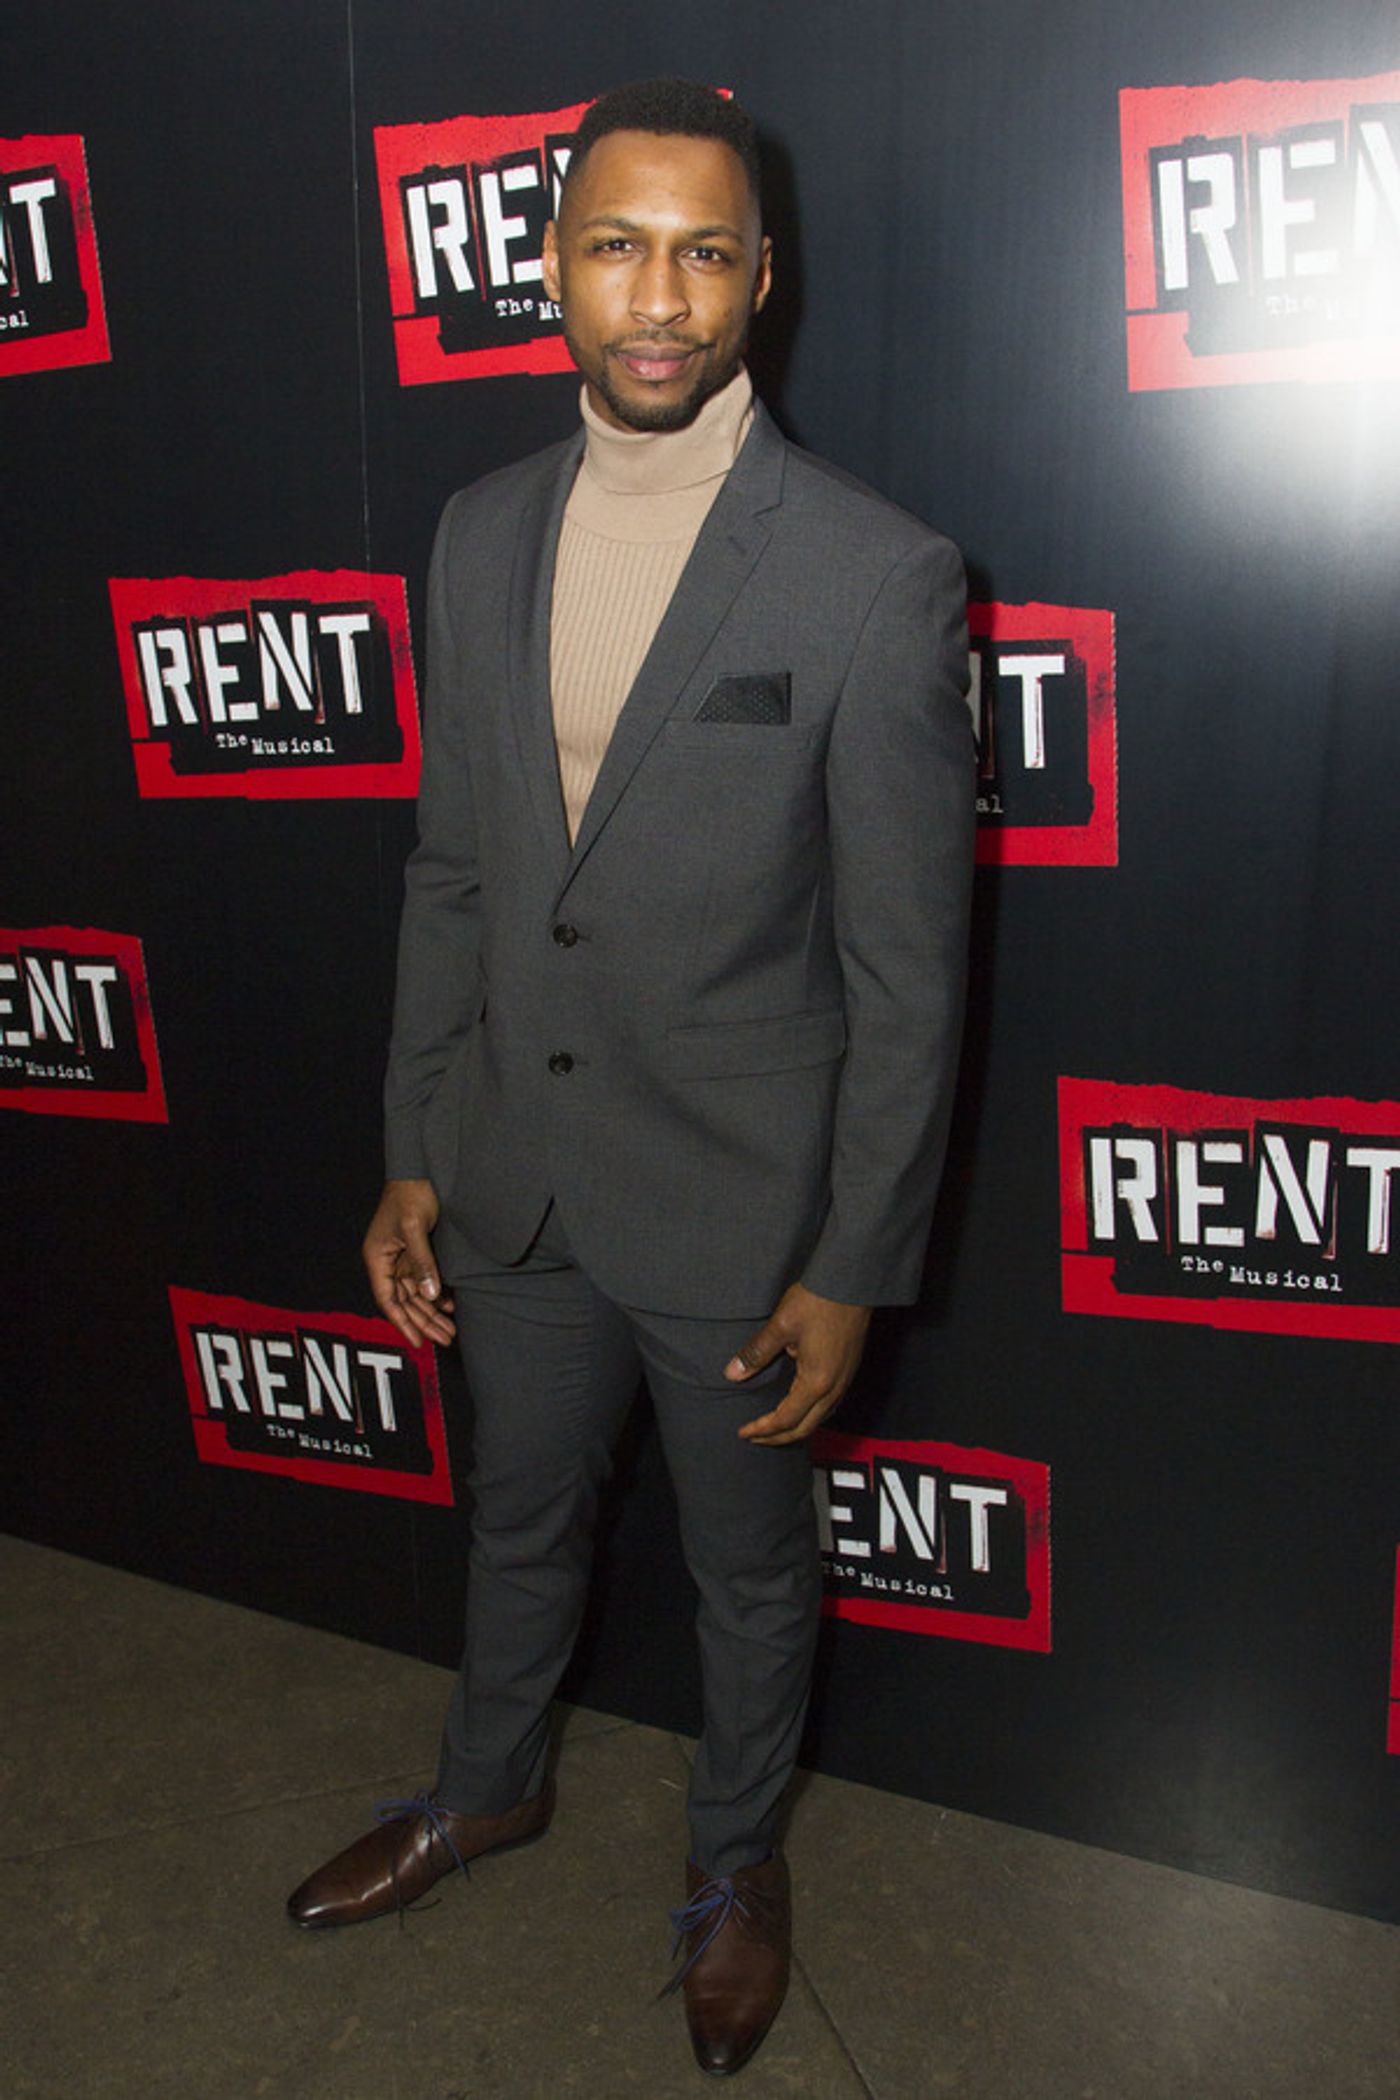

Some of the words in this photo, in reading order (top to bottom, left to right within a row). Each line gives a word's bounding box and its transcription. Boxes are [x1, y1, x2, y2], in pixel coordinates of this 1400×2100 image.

[406, 149, 572, 297] RE
[495, 298, 533, 317] The
[138, 612, 370, 726] RENT
[215, 733, 248, 748] The
[251, 737, 335, 755] Musical
[26, 1061, 95, 1081] Musical
[1090, 1134, 1400, 1254] RENT
[1181, 1256, 1224, 1273] The
[1229, 1266, 1342, 1292] Musical
[196, 1332, 403, 1432] RENT
[266, 1424, 295, 1438] The
[299, 1434, 373, 1458] Musical
[861, 1572, 954, 1600] Musical
